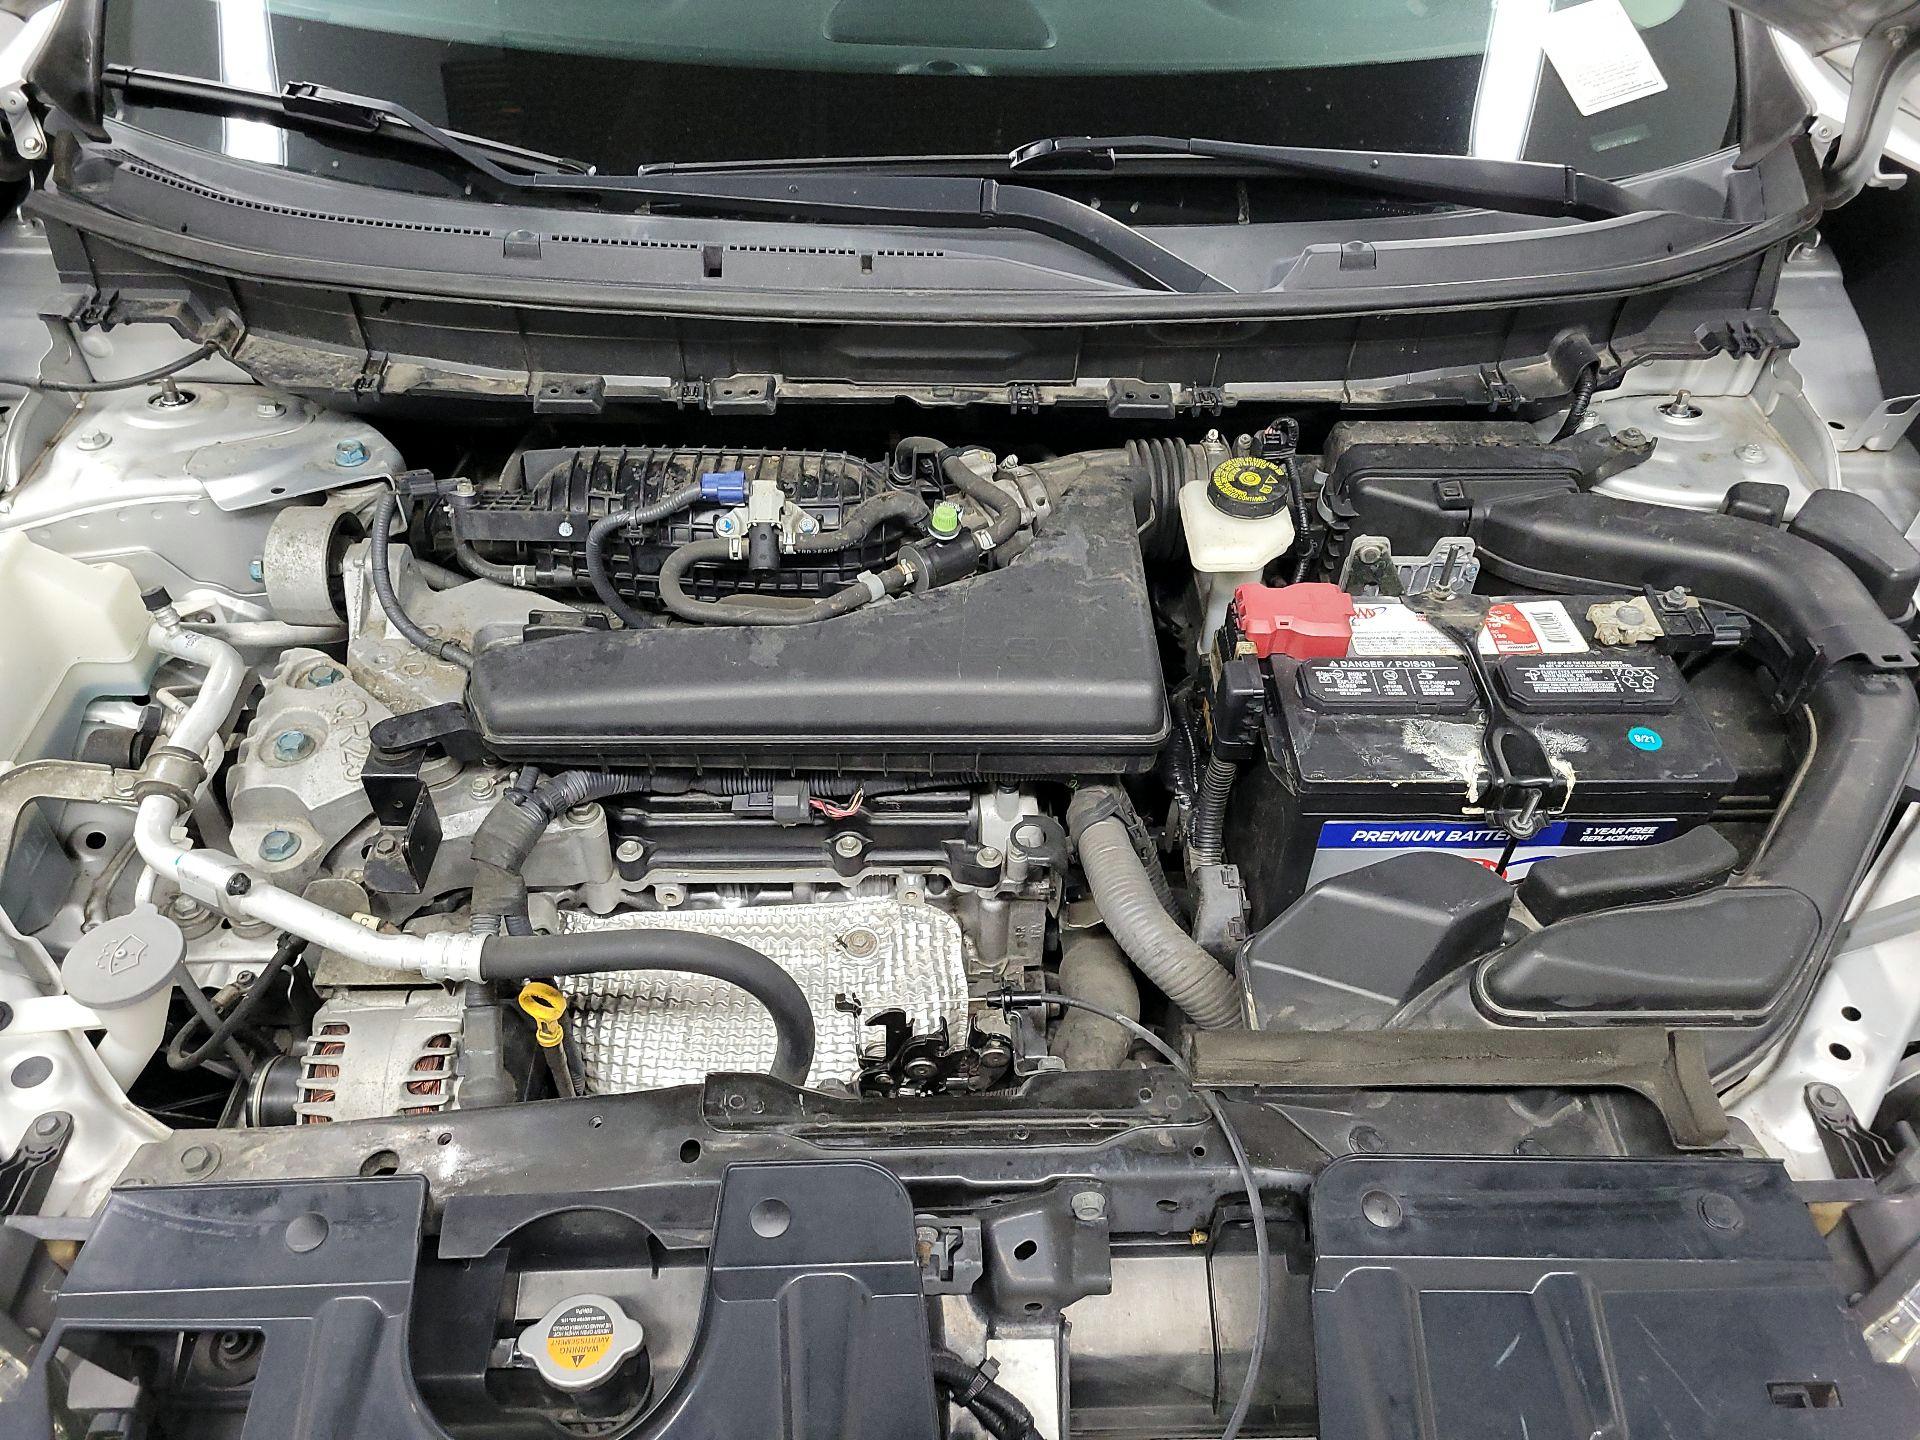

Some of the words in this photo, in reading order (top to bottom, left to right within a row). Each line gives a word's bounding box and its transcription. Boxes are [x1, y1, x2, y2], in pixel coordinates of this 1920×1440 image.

[1339, 660, 1385, 668] DANGER
[1394, 660, 1436, 668] POISON
[1582, 827, 1594, 835] 3
[1594, 827, 1627, 835] YEAR
[1625, 826, 1660, 834] FREE
[1351, 830, 1446, 842] PREMIUM
[1445, 829, 1511, 842] BATTE
[551, 1336, 610, 1346] AVERTISSEMENT
[560, 1345, 599, 1354] WARNING
